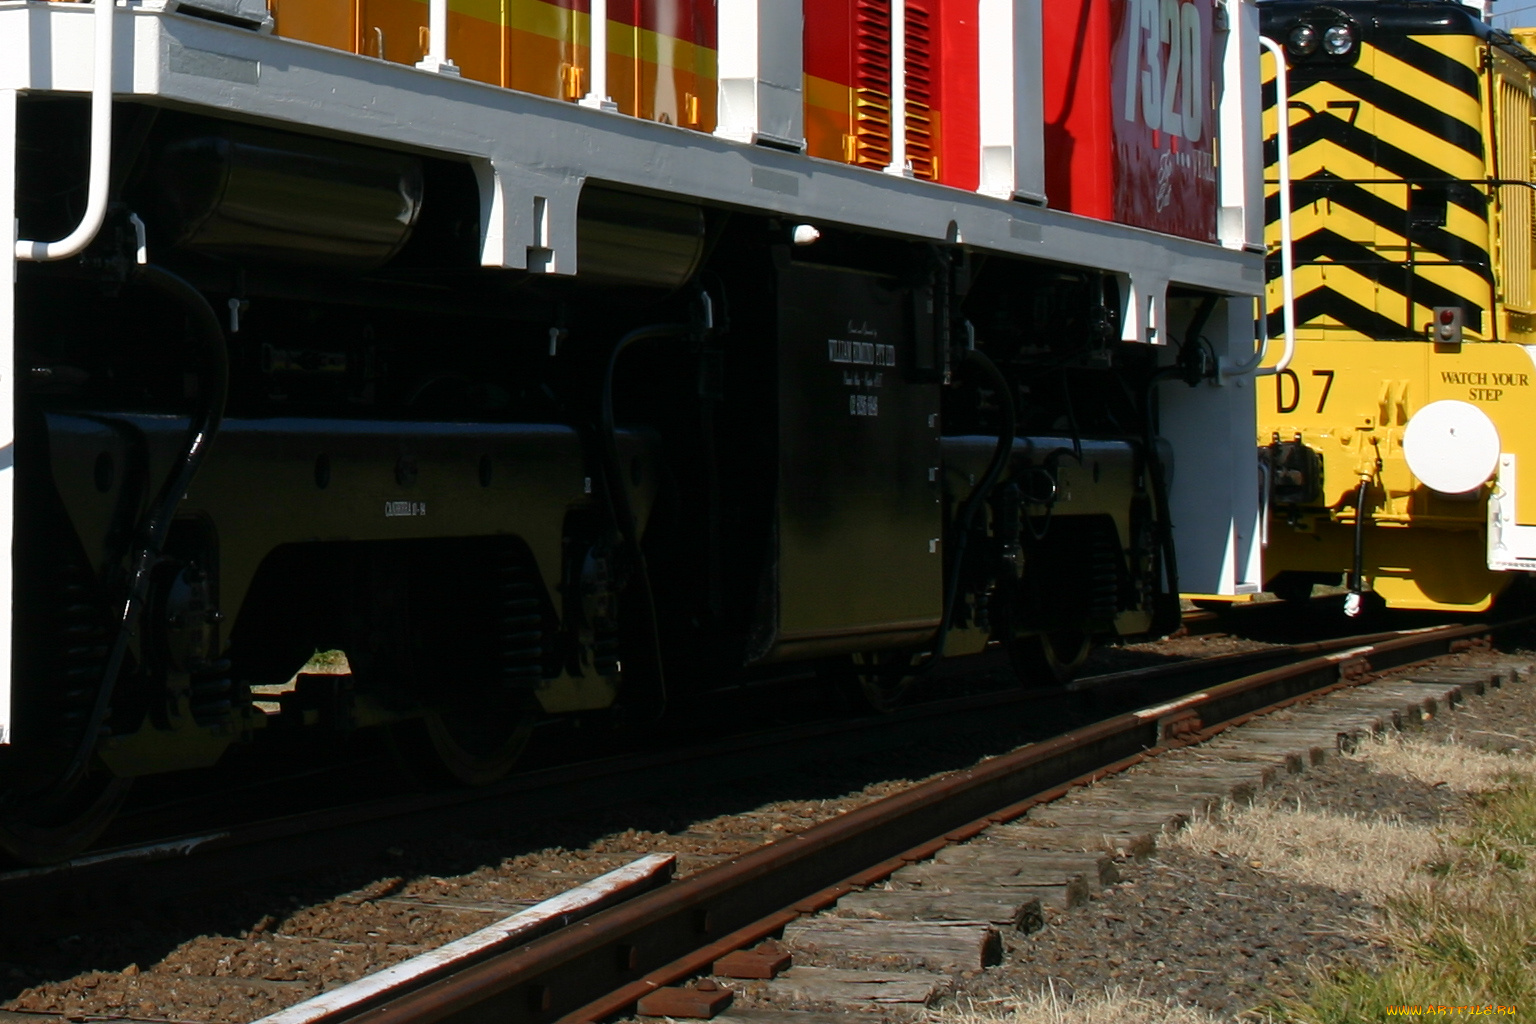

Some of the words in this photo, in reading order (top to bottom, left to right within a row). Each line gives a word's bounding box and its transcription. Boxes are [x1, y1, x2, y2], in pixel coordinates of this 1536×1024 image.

[1441, 371, 1487, 385] WATCH
[1492, 372, 1529, 386] YOUR
[1469, 387, 1503, 402] STEP
